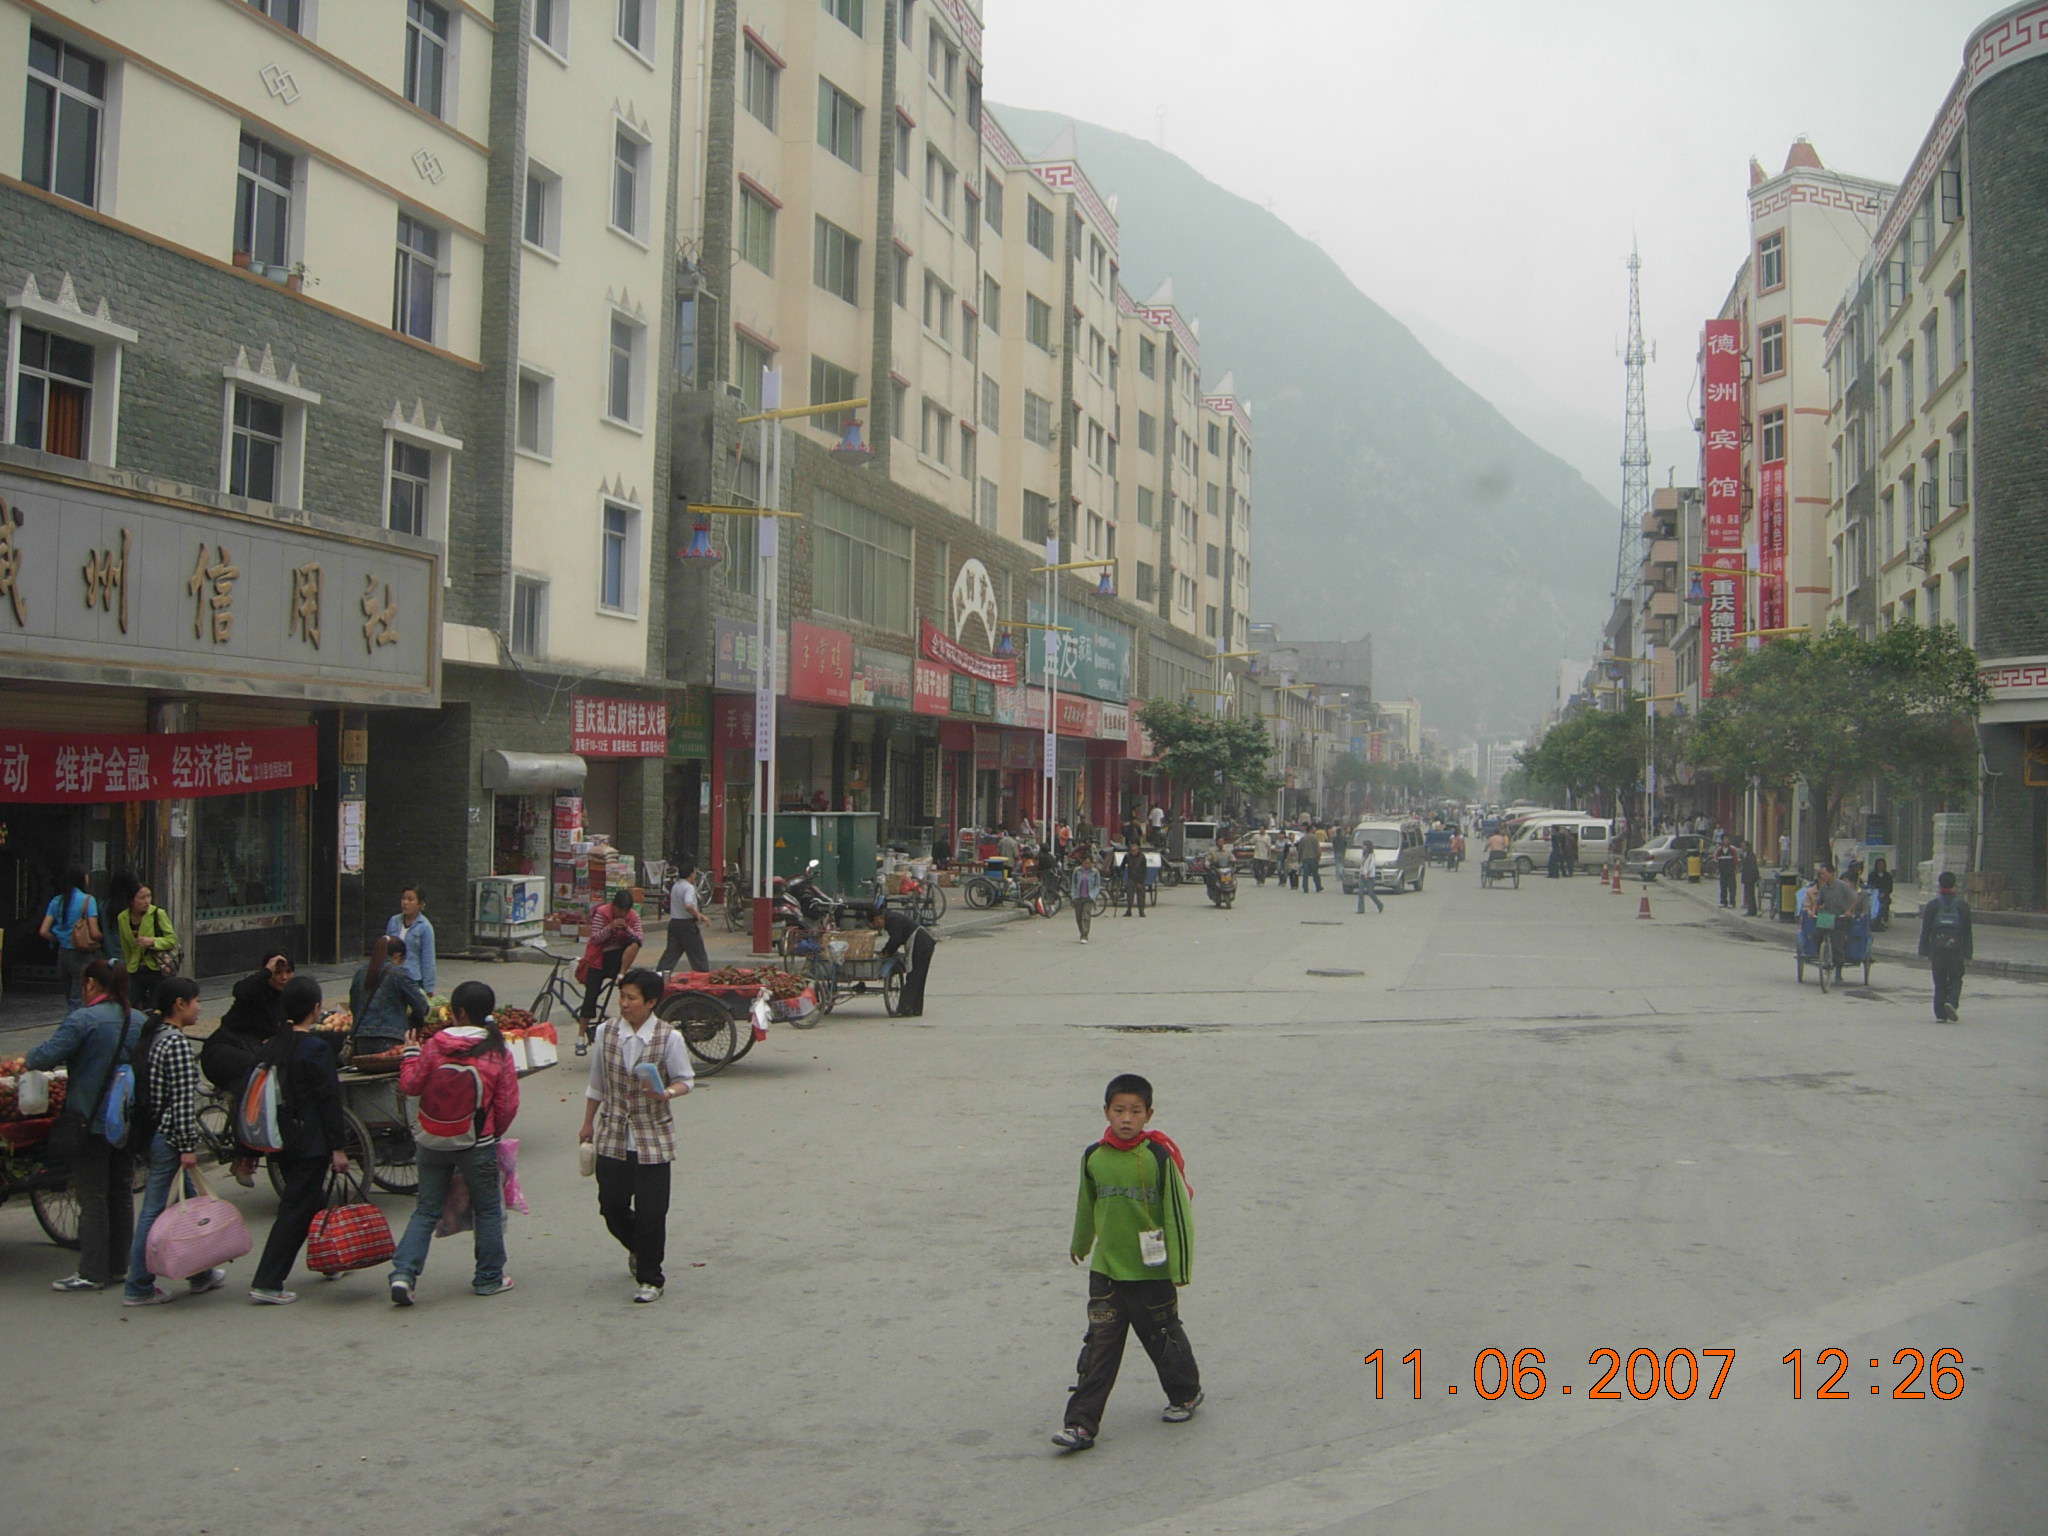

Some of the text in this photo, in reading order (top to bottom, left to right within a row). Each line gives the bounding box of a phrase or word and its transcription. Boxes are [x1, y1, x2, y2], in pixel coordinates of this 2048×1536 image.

[1708, 334, 1739, 498] 德洲宾馆
[349, 774, 357, 793] 5
